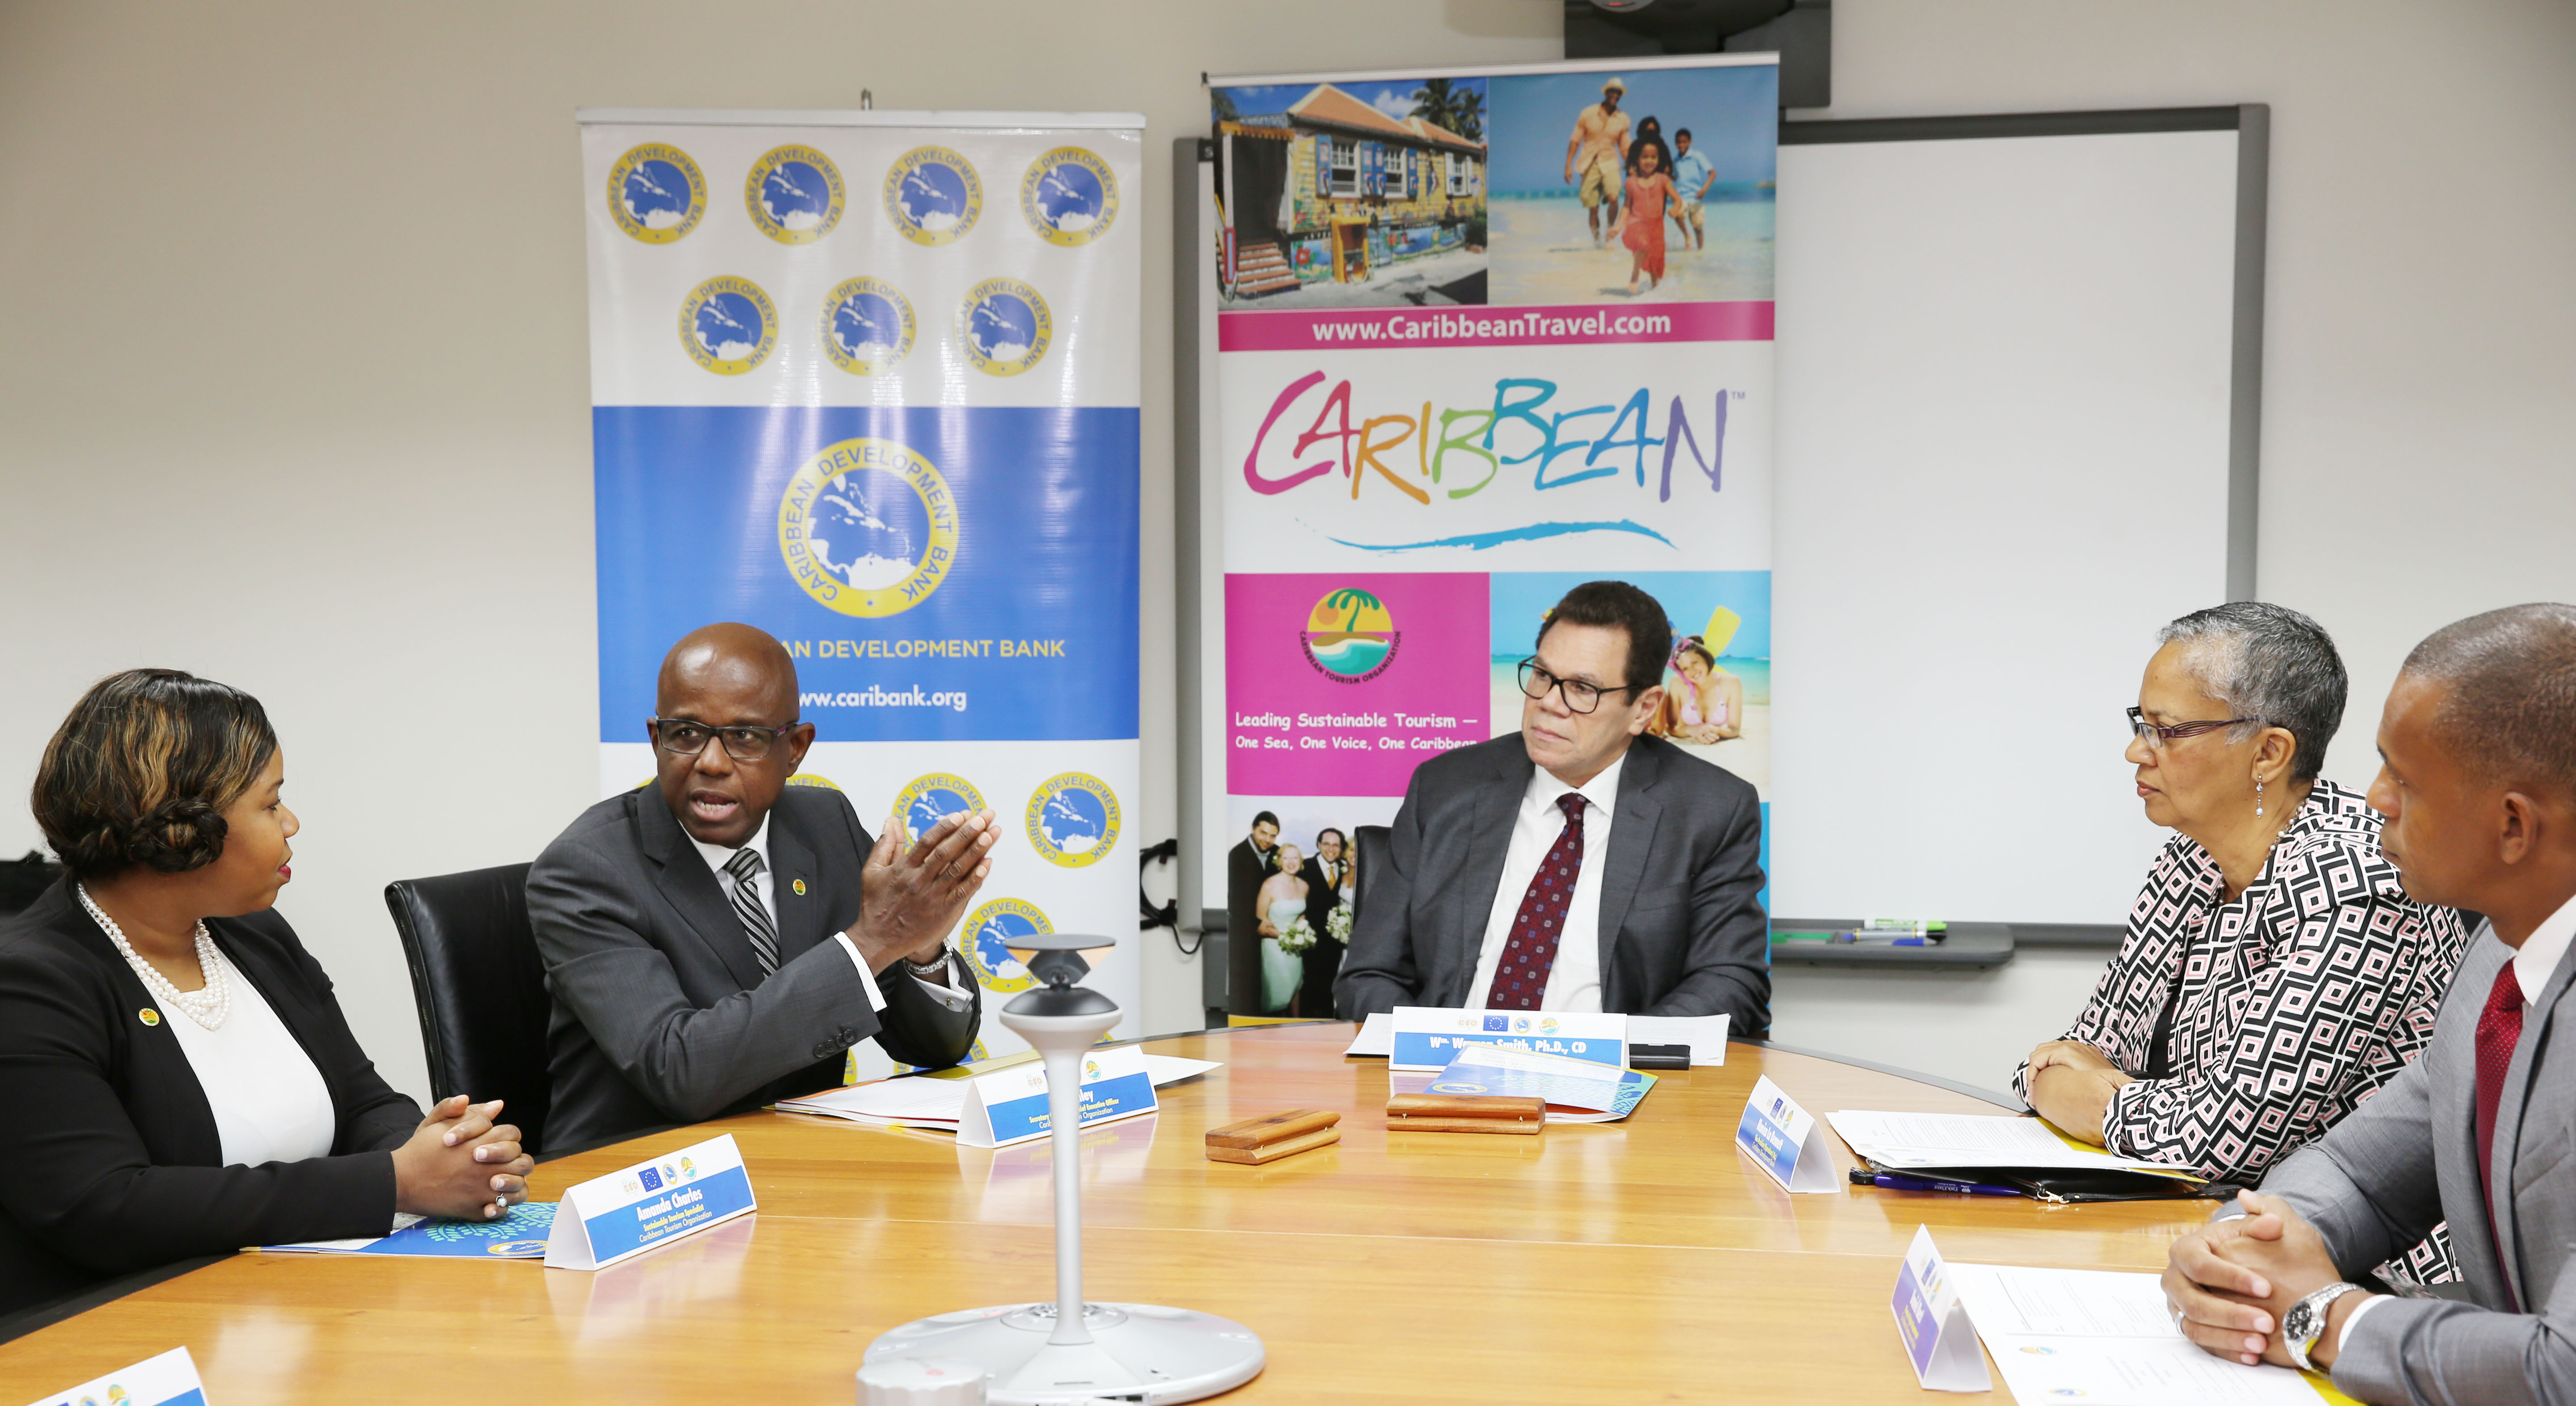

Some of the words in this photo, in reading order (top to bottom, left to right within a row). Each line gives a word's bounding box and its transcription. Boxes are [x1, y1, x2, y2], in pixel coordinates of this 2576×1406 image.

[627, 147, 704, 198] DEVELOPMENT
[766, 148, 842, 199] DEVELOPMENT
[904, 149, 979, 199] DEVELOPMENT
[1042, 151, 1116, 199] DEVELOPMENT
[700, 280, 775, 329] DEVELOPMENT
[1312, 310, 1671, 342] www.CaribbeanTravel.com
[1243, 369, 1728, 504] CARIBBEAN
[786, 479, 838, 601] CARIBBEAN
[818, 446, 952, 533] DEVELOPMENT
[900, 546, 949, 601] BANK
[819, 640, 993, 657] DEVELOPMENT
[1000, 640, 1065, 657] BANK
[1300, 631, 1324, 673] CARIBBEAN
[1325, 671, 1360, 684] TOURISM
[1363, 631, 1401, 682] ORGANIZATION
[799, 684, 967, 712] ww.caribank.org
[1235, 711, 1291, 731] Leading
[1297, 712, 1387, 728] Sustainable
[1394, 713, 1457, 728] Tourism
[1235, 736, 1259, 749] One
[1263, 736, 1293, 751] Sea,
[1300, 736, 1327, 749] One
[1332, 736, 1372, 751] Voice,
[1378, 736, 1405, 750] One
[911, 776, 983, 815] DEVELOPMEN
[1029, 793, 1057, 860] CARIBBEAN
[1046, 776, 1118, 822] DEVELOPMENT
[1090, 829, 1116, 860] BANK
[980, 901, 1051, 934] DEVELOPME
[1535, 1039, 1569, 1055] Ph.D.,
[1571, 1041, 1587, 1054] CD
[1029, 1114, 1049, 1123] Secretary
[1086, 1101, 1106, 1110] Executive
[1106, 1097, 1119, 1106] Officer
[1039, 1120, 1052, 1129] Carib
[1083, 1107, 1113, 1119] Organization
[636, 1197, 673, 1222] Amanda
[671, 1187, 703, 1208] Charles
[643, 1217, 669, 1232] Sustainable
[667, 1212, 685, 1223] Tourism
[684, 1203, 705, 1217] Specialist
[639, 1229, 664, 1243] Caribbean
[664, 1221, 682, 1233] Tourism
[682, 1211, 712, 1227] Organization
